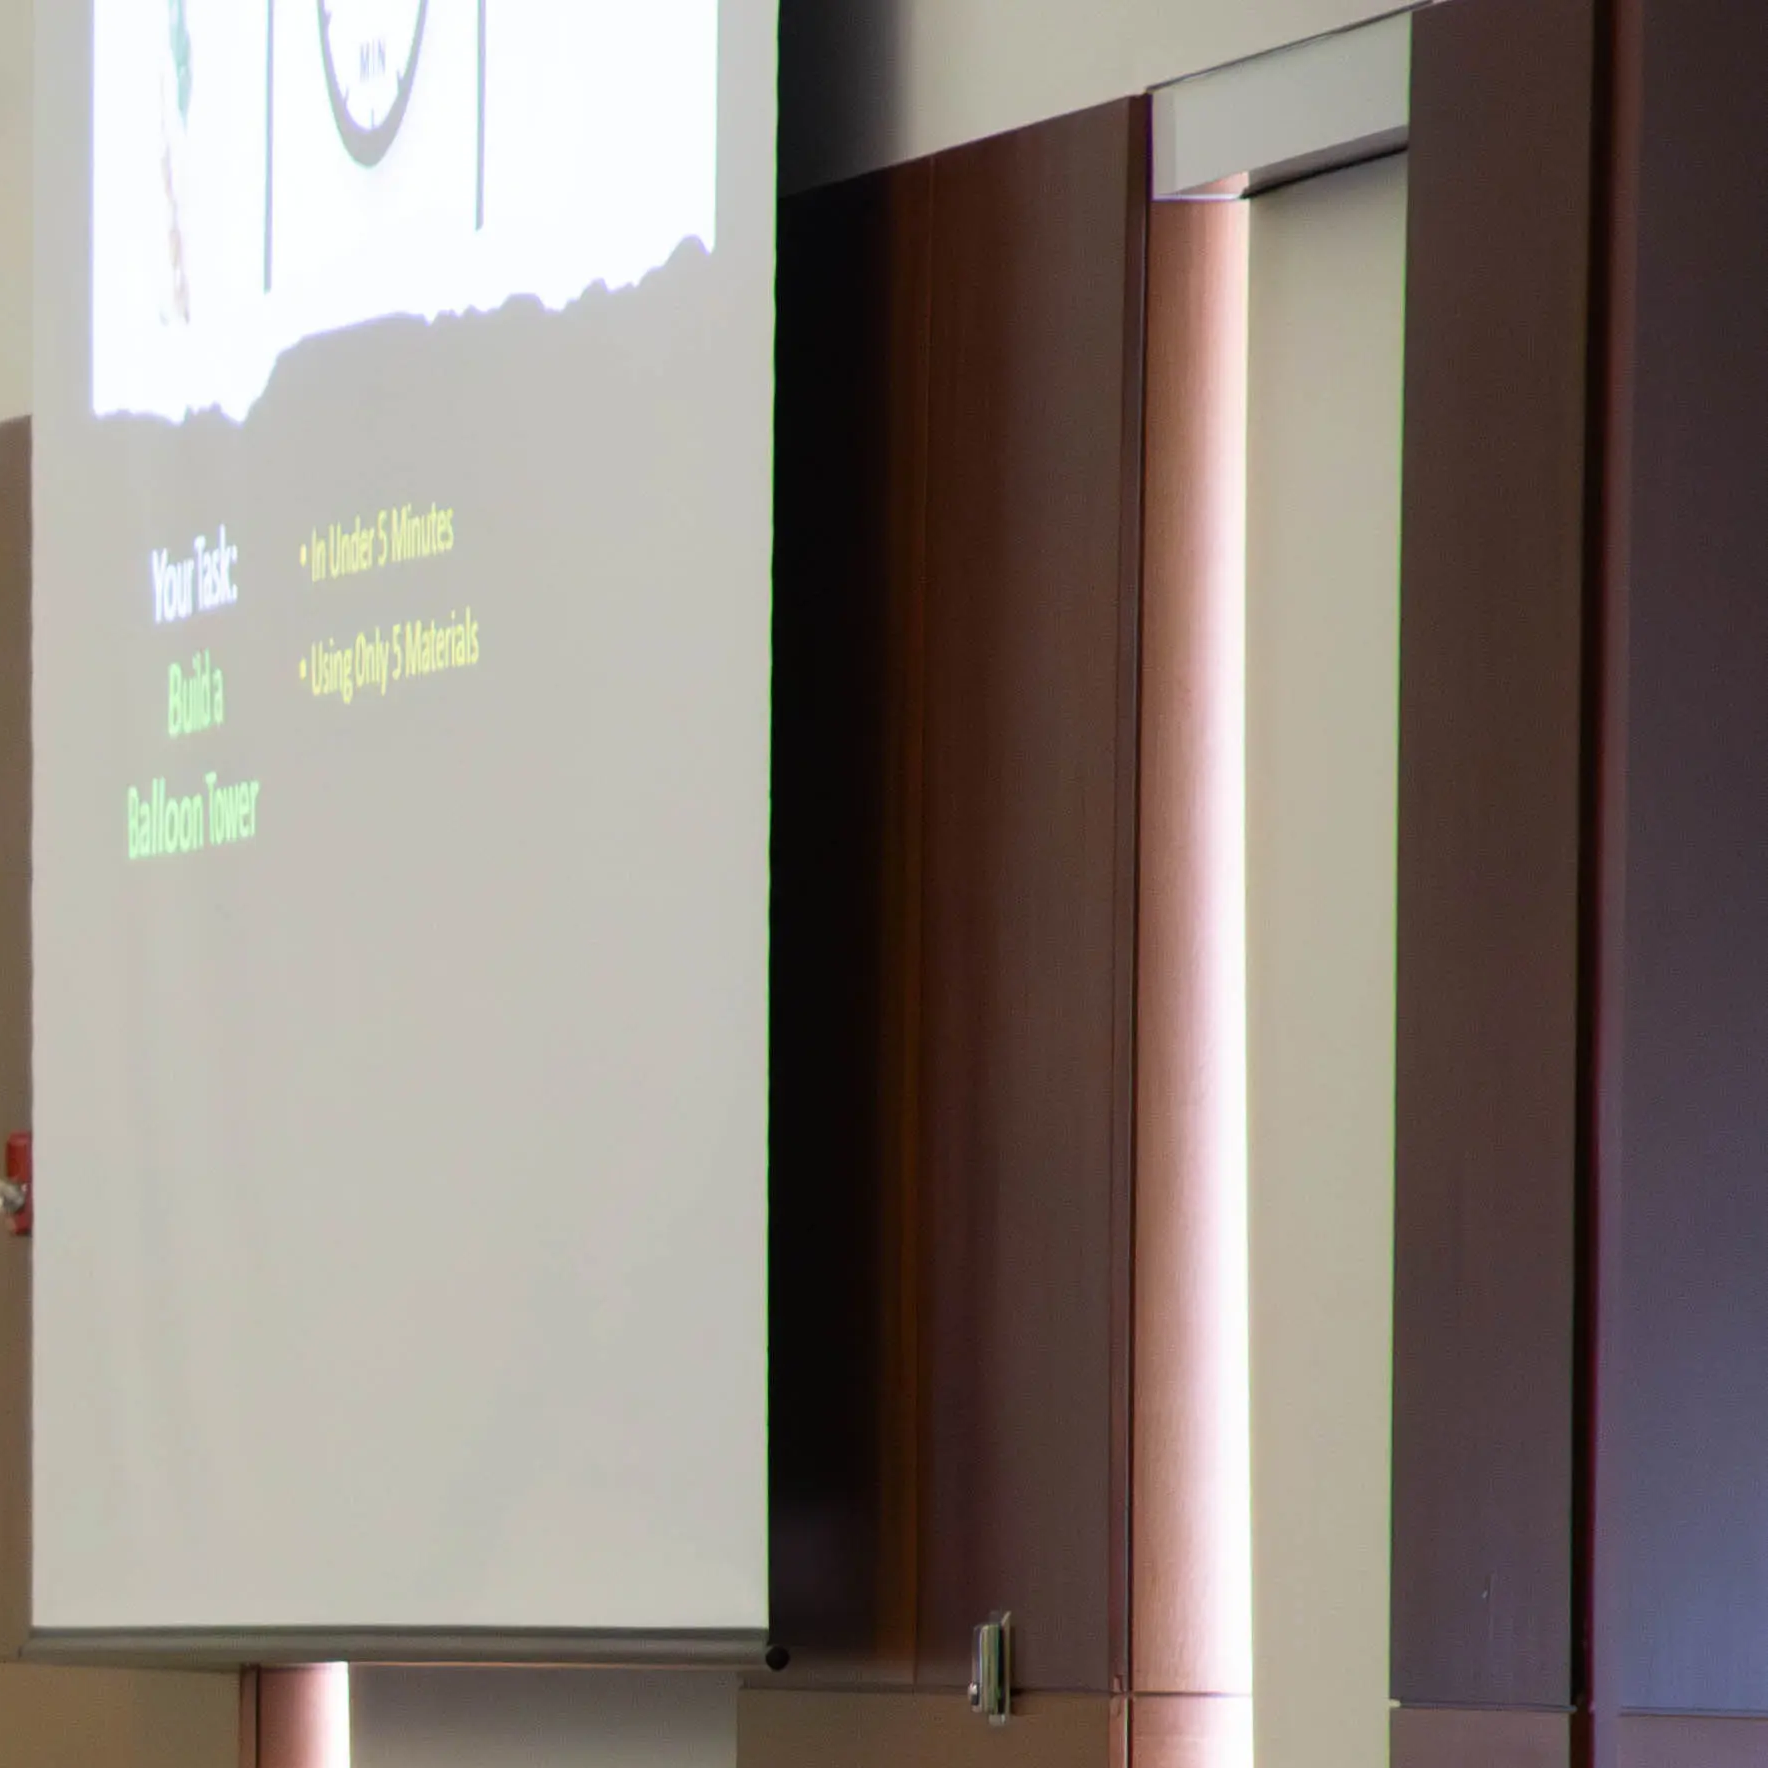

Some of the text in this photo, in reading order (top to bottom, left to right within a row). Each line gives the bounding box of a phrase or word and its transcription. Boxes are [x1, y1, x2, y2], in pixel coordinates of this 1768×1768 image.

[151, 523, 238, 624] Your Task:
[311, 501, 455, 582] In Under 5 Minutes
[168, 647, 224, 738] Build a
[312, 605, 479, 704] Using Only 5 Materials
[127, 771, 260, 860] Balloon Tower
